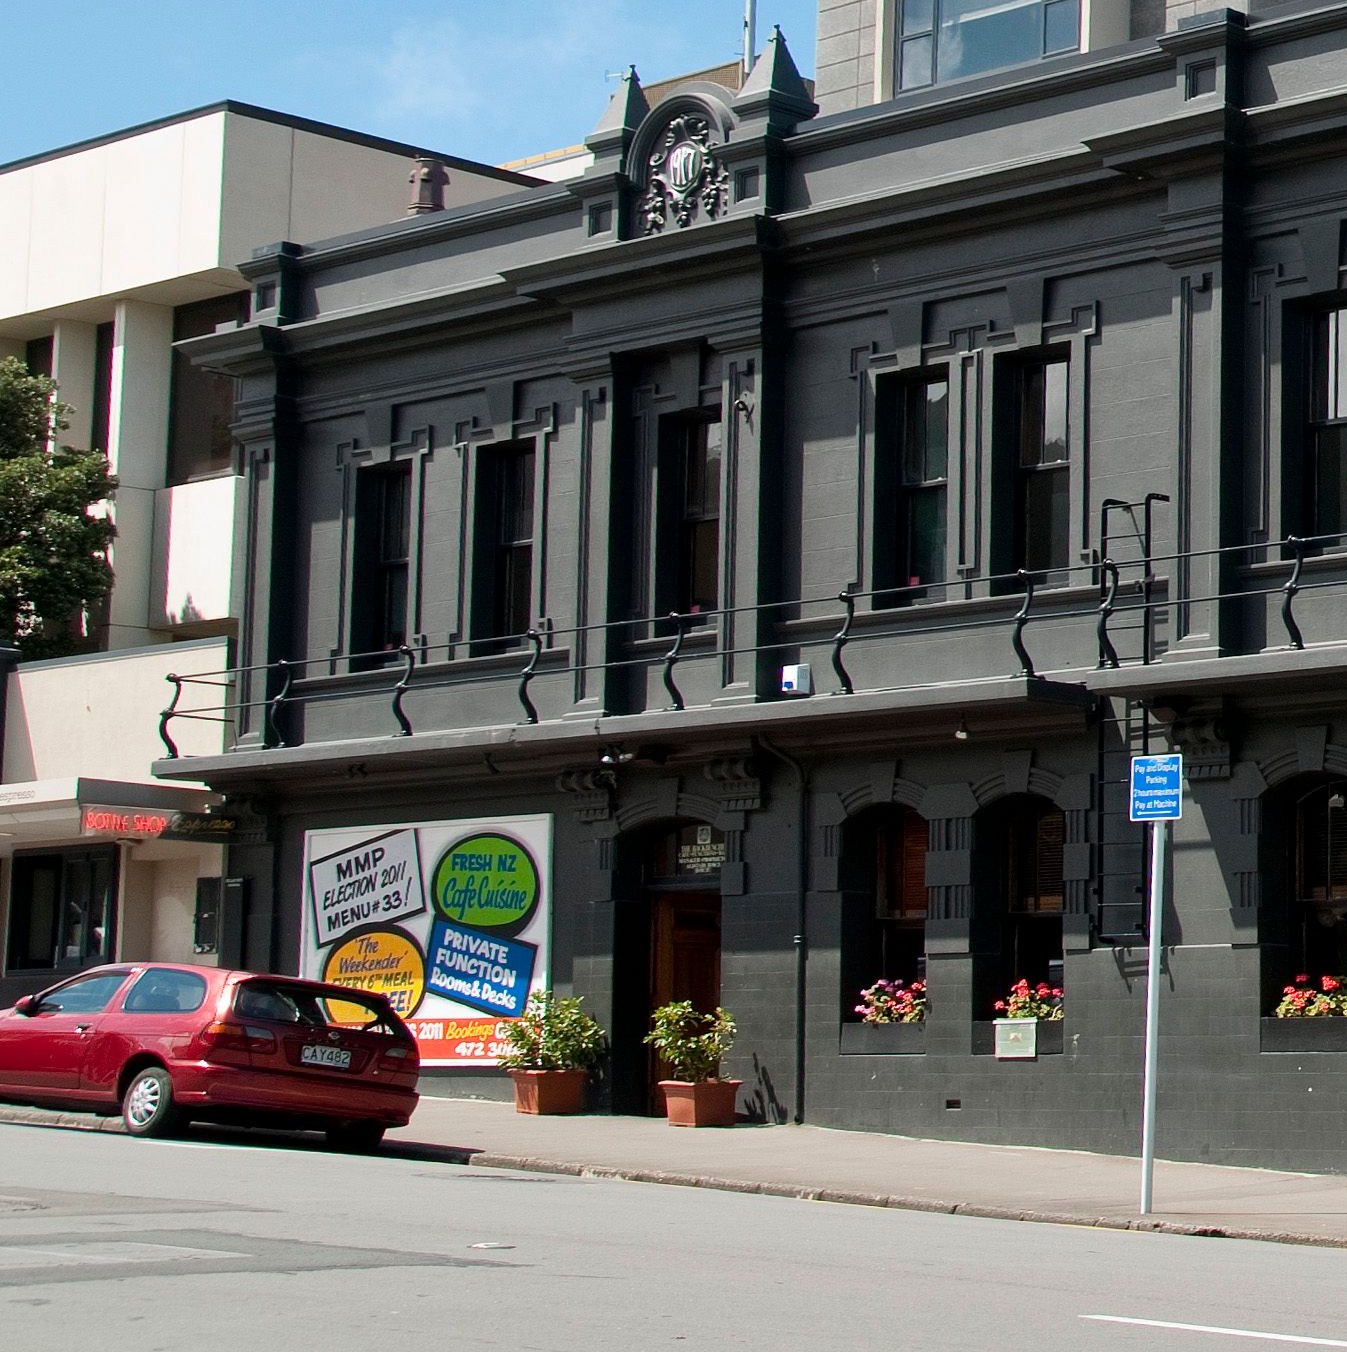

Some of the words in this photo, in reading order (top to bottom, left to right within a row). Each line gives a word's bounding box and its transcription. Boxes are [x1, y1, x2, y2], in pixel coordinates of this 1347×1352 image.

[1135, 764, 1145, 774] Pay
[1145, 776, 1167, 785] Parking
[1135, 800, 1145, 810] Pay
[133, 814, 167, 833] SHOP
[336, 847, 386, 882] MMP
[451, 853, 492, 872] FRESH
[497, 854, 517, 872] NZ
[323, 870, 379, 911] ELECTION
[381, 860, 407, 889] 2011
[443, 876, 479, 920] Cafe
[477, 879, 528, 911] Cuisine
[443, 928, 509, 963] PRIVATE
[435, 948, 516, 988] FUNCTION
[383, 971, 415, 987] MEAL
[419, 1022, 443, 1040] 2011
[446, 1021, 495, 1041] Bookings
[455, 1042, 485, 1056] 472
